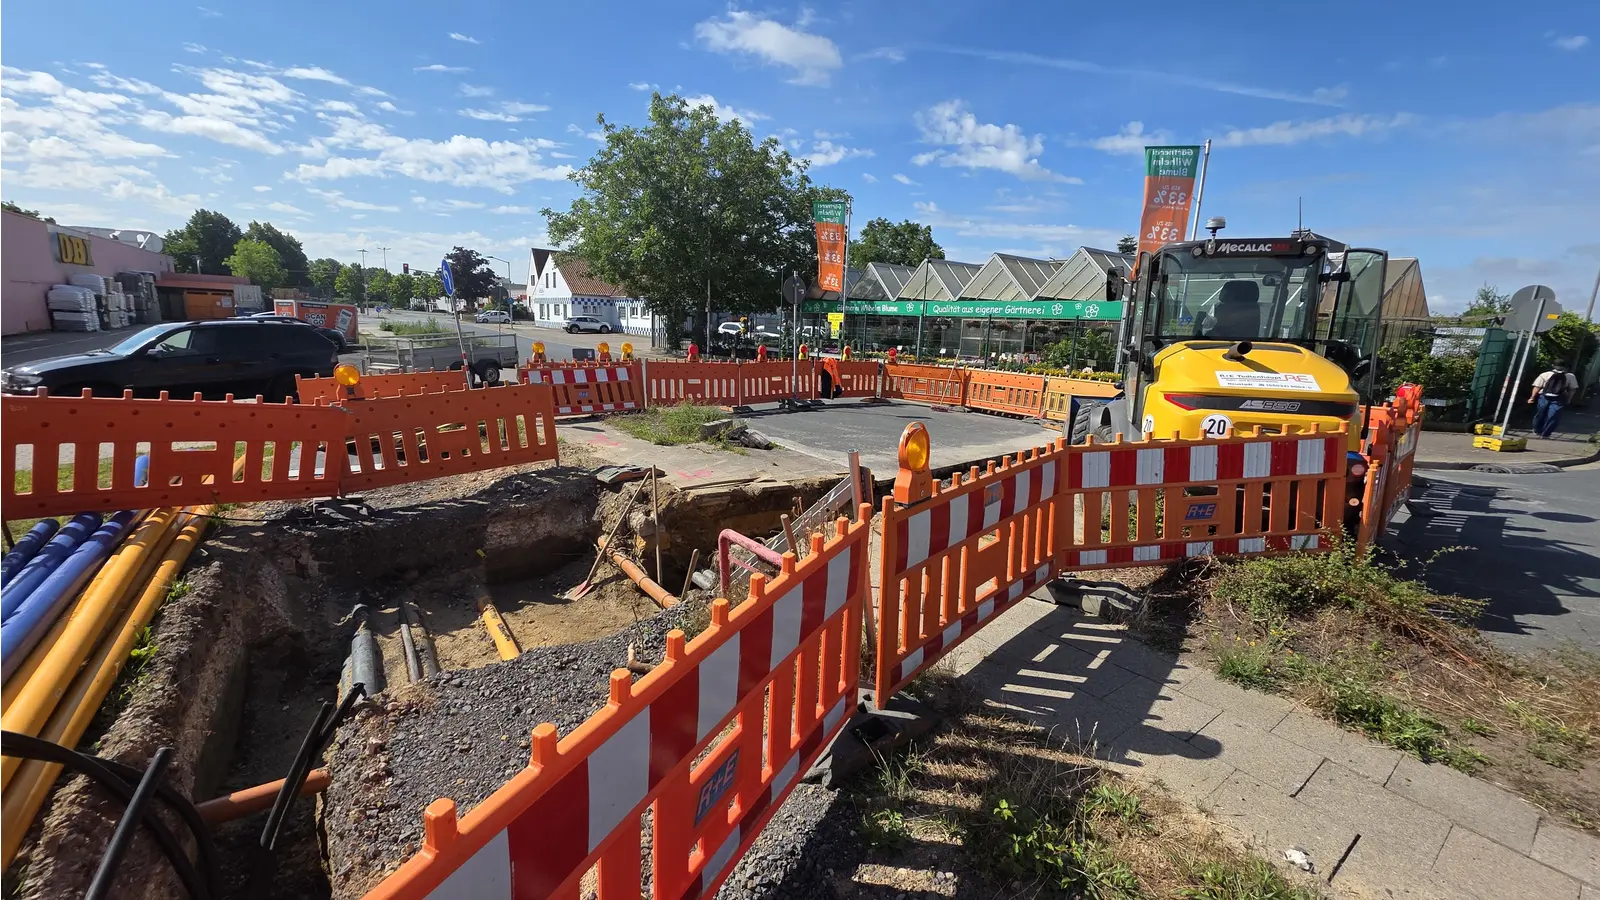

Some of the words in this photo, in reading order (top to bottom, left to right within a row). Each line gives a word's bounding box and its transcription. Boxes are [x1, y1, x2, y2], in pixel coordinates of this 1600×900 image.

[881, 304, 898, 312] Blume
[933, 305, 960, 314] Qualität
[975, 305, 1003, 315] eigener
[1004, 305, 1046, 315] Gärtnerei
[1143, 418, 1152, 433] 20
[1206, 419, 1227, 435] 20
[1187, 504, 1216, 517] R+E
[698, 752, 737, 817] R+E
